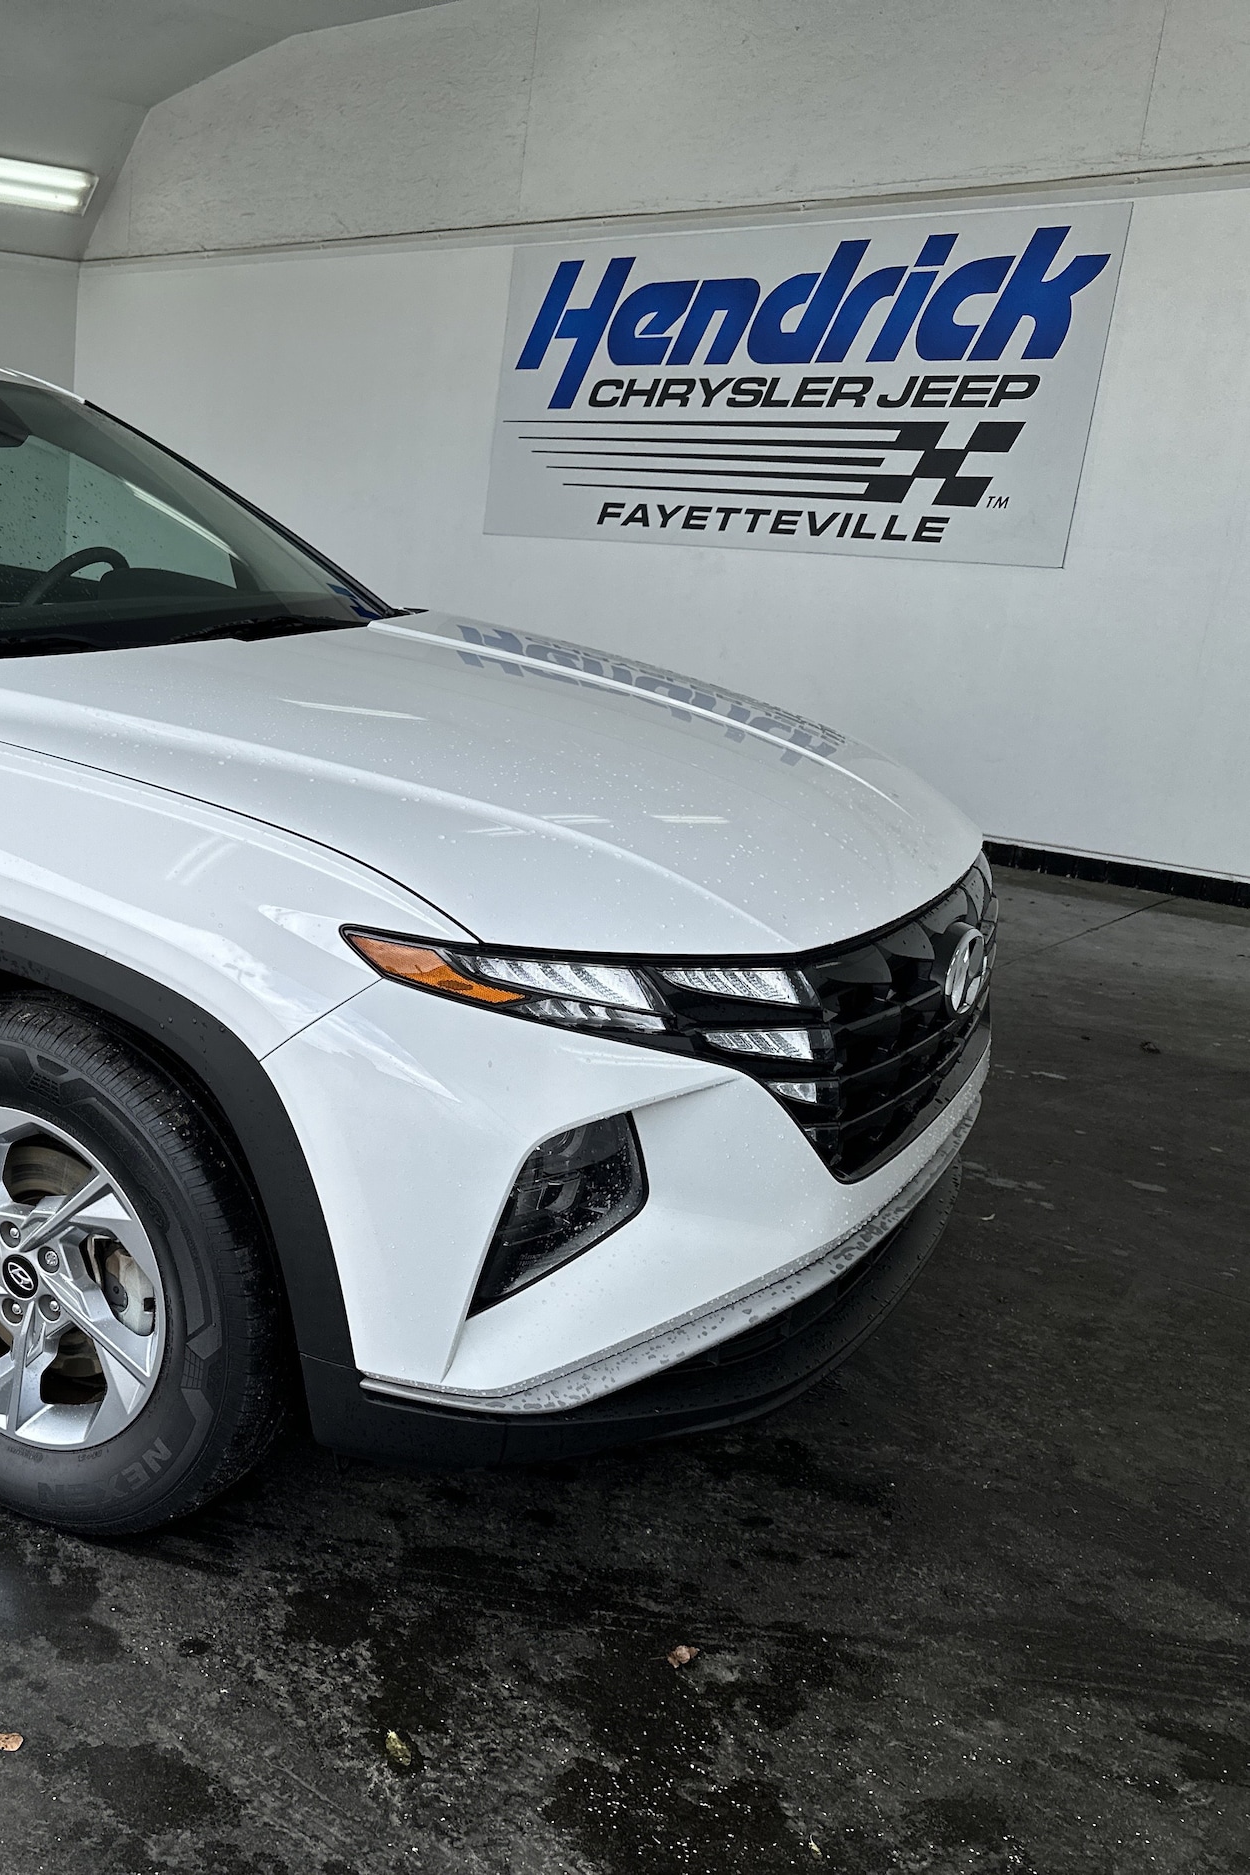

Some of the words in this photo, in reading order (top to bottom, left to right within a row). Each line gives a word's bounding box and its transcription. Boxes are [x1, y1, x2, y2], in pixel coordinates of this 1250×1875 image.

[515, 226, 1111, 409] Hendrick
[587, 376, 874, 409] CHRYSLER
[876, 374, 1041, 409] JEEP
[597, 502, 950, 543] FAYETTEVILLE
[986, 495, 1010, 509] TM
[37, 1436, 172, 1508] NEXEN
